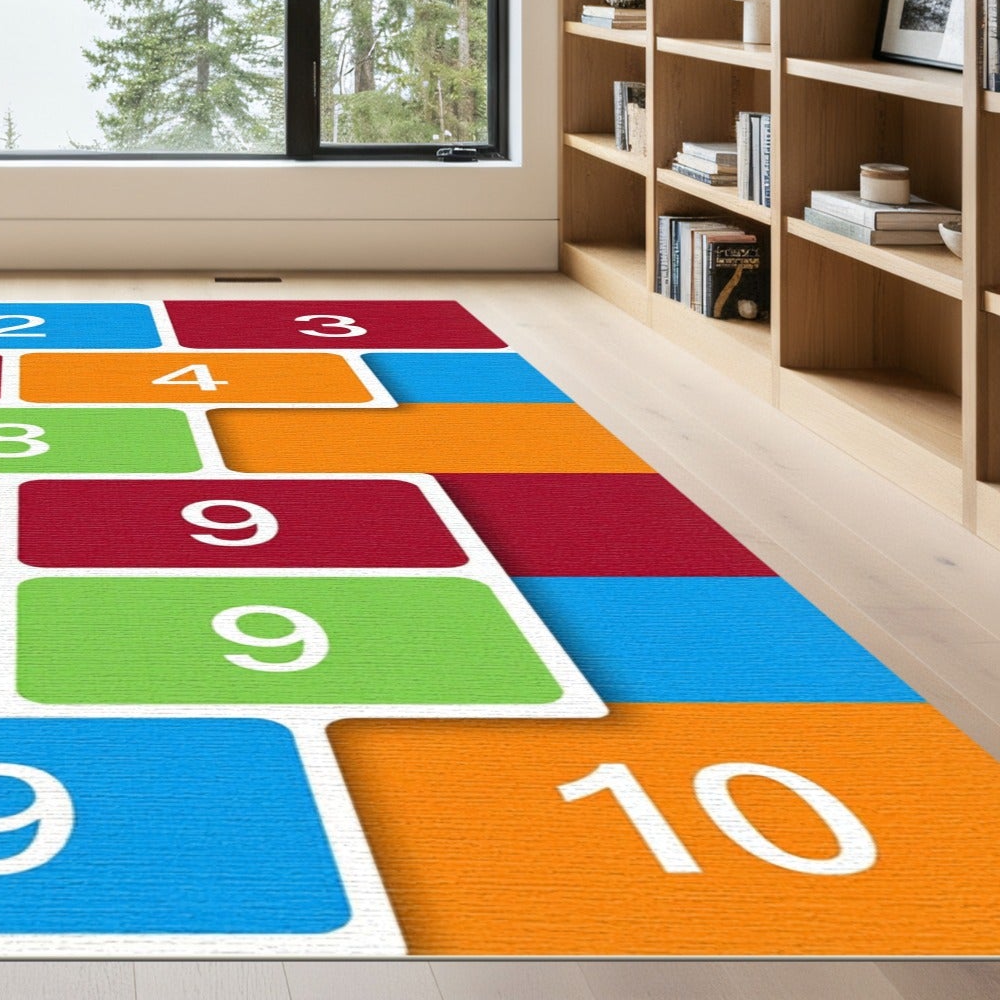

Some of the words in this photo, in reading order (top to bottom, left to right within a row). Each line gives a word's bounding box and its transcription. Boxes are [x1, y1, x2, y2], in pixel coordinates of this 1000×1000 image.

[293, 314, 368, 338] 3
[151, 364, 229, 391] 4
[180, 499, 279, 547] 9
[210, 604, 330, 673] 9
[557, 762, 878, 875] 10
